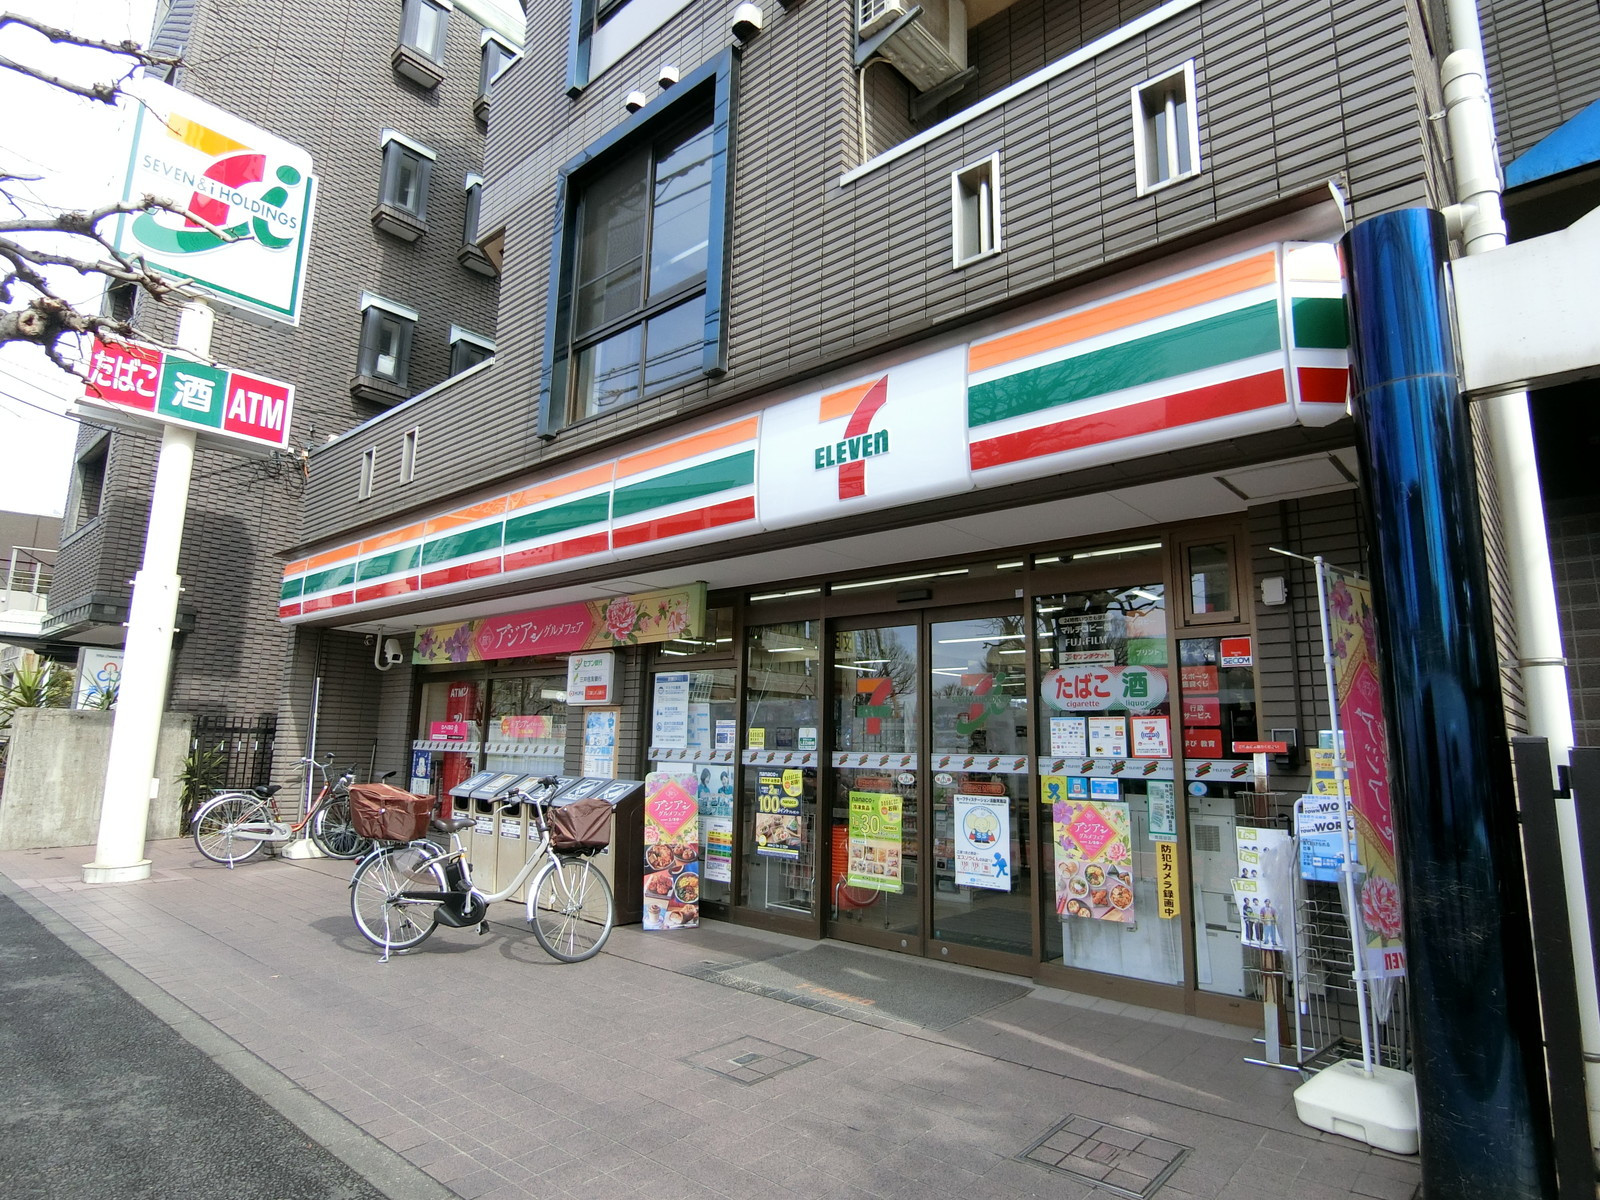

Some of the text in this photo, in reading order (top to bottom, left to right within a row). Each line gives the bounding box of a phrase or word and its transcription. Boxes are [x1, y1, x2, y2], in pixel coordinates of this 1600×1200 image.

[219, 186, 297, 229] HOLDINGS
[89, 350, 158, 398] たばこ
[171, 371, 216, 414] 酒
[228, 388, 285, 431] ATM
[1136, 649, 1160, 657] プリント
[1223, 656, 1250, 665] SECOM
[1182, 672, 1209, 680] スポーツ
[450, 687, 464, 698] ATM
[1055, 672, 1111, 700] たばこ
[1121, 671, 1148, 699] 酒
[1066, 700, 1100, 708] cigarette
[1125, 699, 1150, 707] liquor
[1183, 712, 1212, 720] サービス
[654, 799, 692, 812] アジアン
[758, 794, 780, 814] 100
[860, 813, 881, 834] 30
[1073, 821, 1109, 834] アジアン
[1159, 844, 1175, 917] 防犯カメラ録画中
